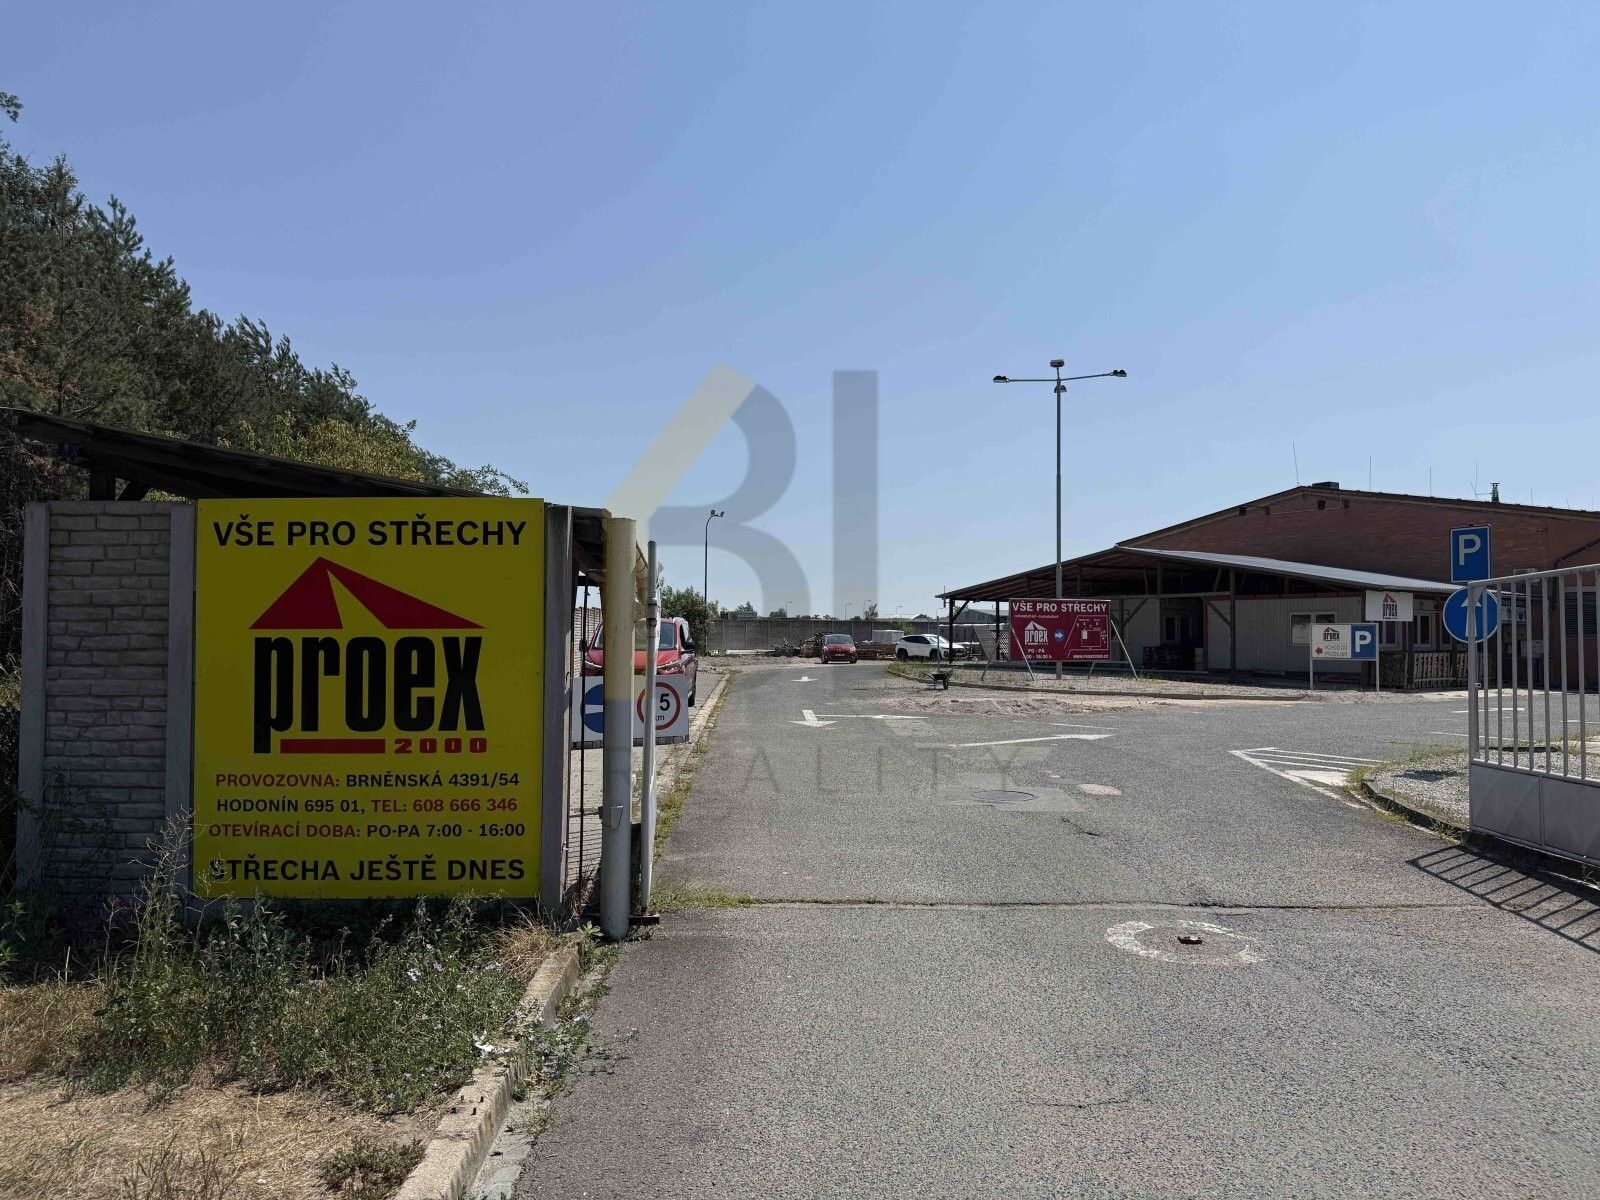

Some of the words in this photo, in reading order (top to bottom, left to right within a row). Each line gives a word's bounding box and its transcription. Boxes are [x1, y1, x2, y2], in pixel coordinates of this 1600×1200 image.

[213, 514, 275, 546] VŠE
[287, 520, 356, 546] PRO
[367, 513, 527, 546] STŘECHY
[1458, 534, 1482, 566] P
[1012, 601, 1034, 612] VŠE
[1036, 603, 1058, 612] PRO
[1061, 602, 1107, 613] STŘECHY
[1024, 629, 1048, 646] proex
[1354, 630, 1372, 652] P
[253, 636, 486, 754] proex
[659, 693, 671, 711] 5
[394, 737, 488, 754] 2000
[215, 773, 340, 787] PROVOZOVNA:
[346, 770, 443, 787] BRNĚNSKÁ
[448, 772, 520, 788] 4391/54
[217, 795, 299, 812] HODONÍN
[304, 799, 335, 812] 695
[340, 799, 366, 815] 01,
[371, 799, 407, 812] TEL:
[413, 799, 444, 812] 608
[449, 799, 481, 812] 666
[486, 798, 518, 812] 346
[208, 820, 300, 838] OTEVÍRACÍ
[306, 824, 361, 838] DOBA:
[366, 824, 421, 838] PO-PA
[426, 824, 463, 837] 7:00
[479, 823, 526, 837] 16:00
[210, 853, 340, 880] STŘECHA
[350, 853, 437, 880] JEŠTĚ
[447, 859, 525, 880] DNES
